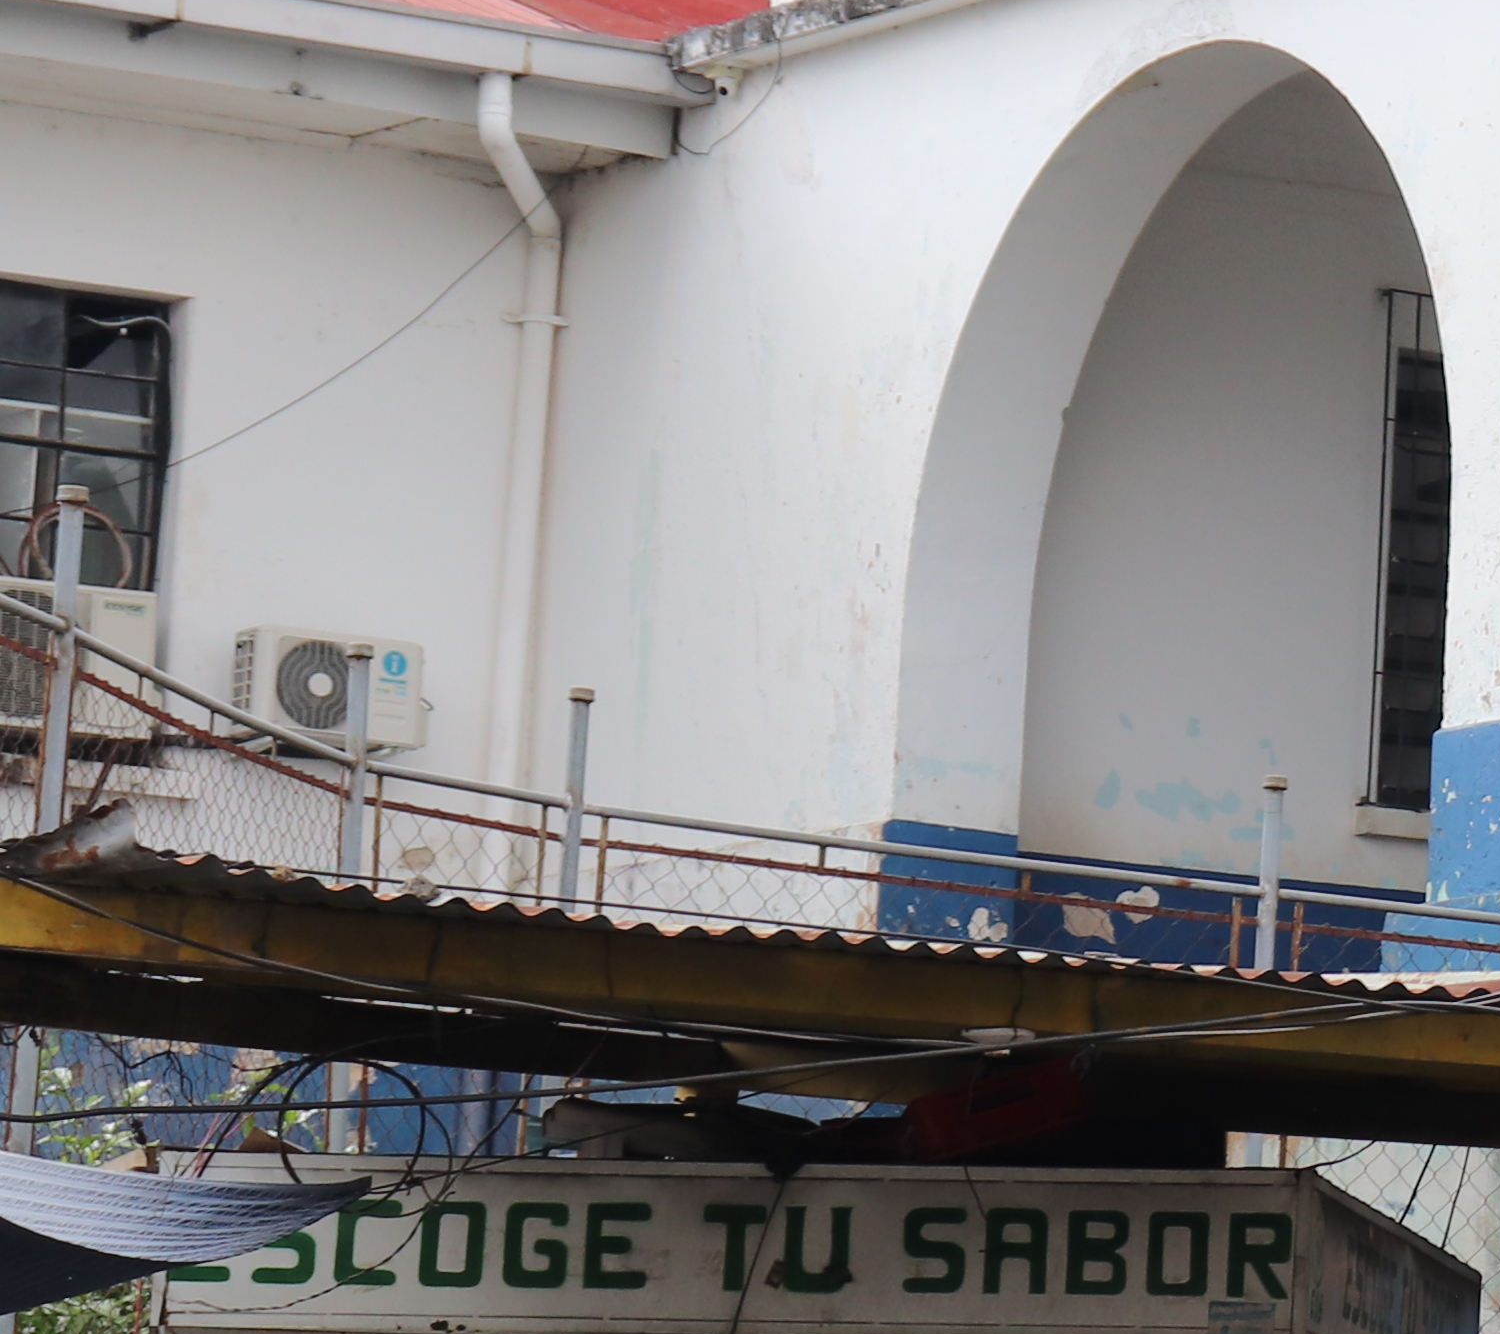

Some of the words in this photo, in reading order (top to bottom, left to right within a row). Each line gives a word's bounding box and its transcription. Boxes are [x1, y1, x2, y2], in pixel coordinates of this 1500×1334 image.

[168, 1200, 652, 1289] SCOGE
[703, 1203, 855, 1294] TU
[901, 1206, 1295, 1301] SABOR
